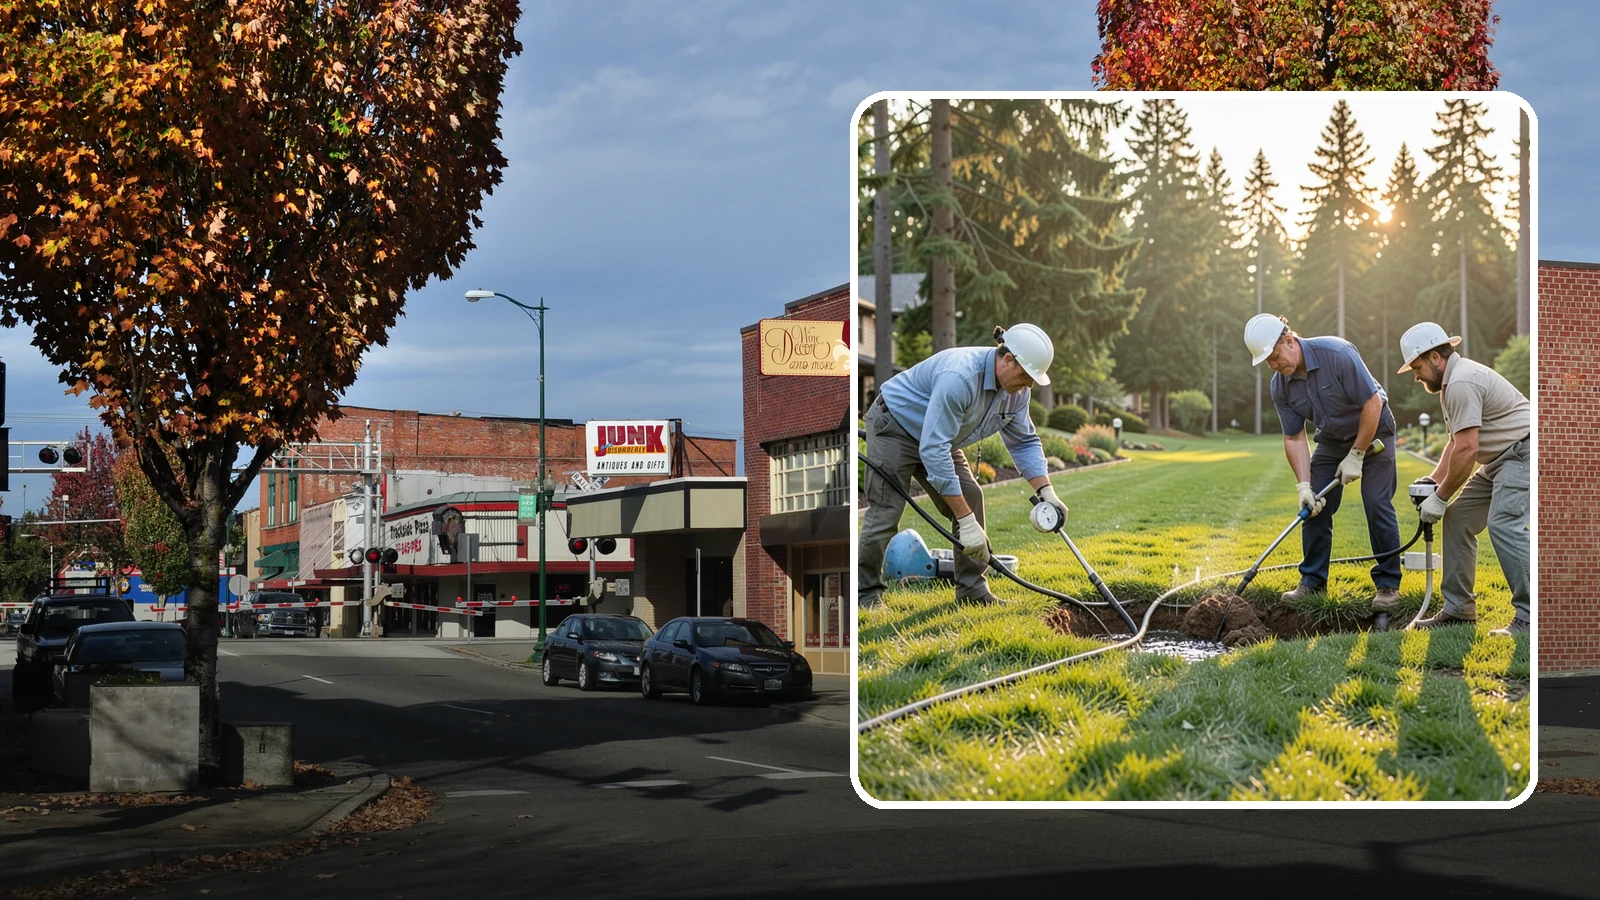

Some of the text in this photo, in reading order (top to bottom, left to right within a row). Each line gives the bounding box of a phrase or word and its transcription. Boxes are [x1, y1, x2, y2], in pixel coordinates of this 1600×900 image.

[595, 425, 665, 457] JUNK
[607, 446, 646, 454] DISORDERLY
[597, 460, 666, 470] ANTIQUES AND GIFTS
[352, 498, 365, 511] CRO
[415, 519, 429, 535] Pizza
